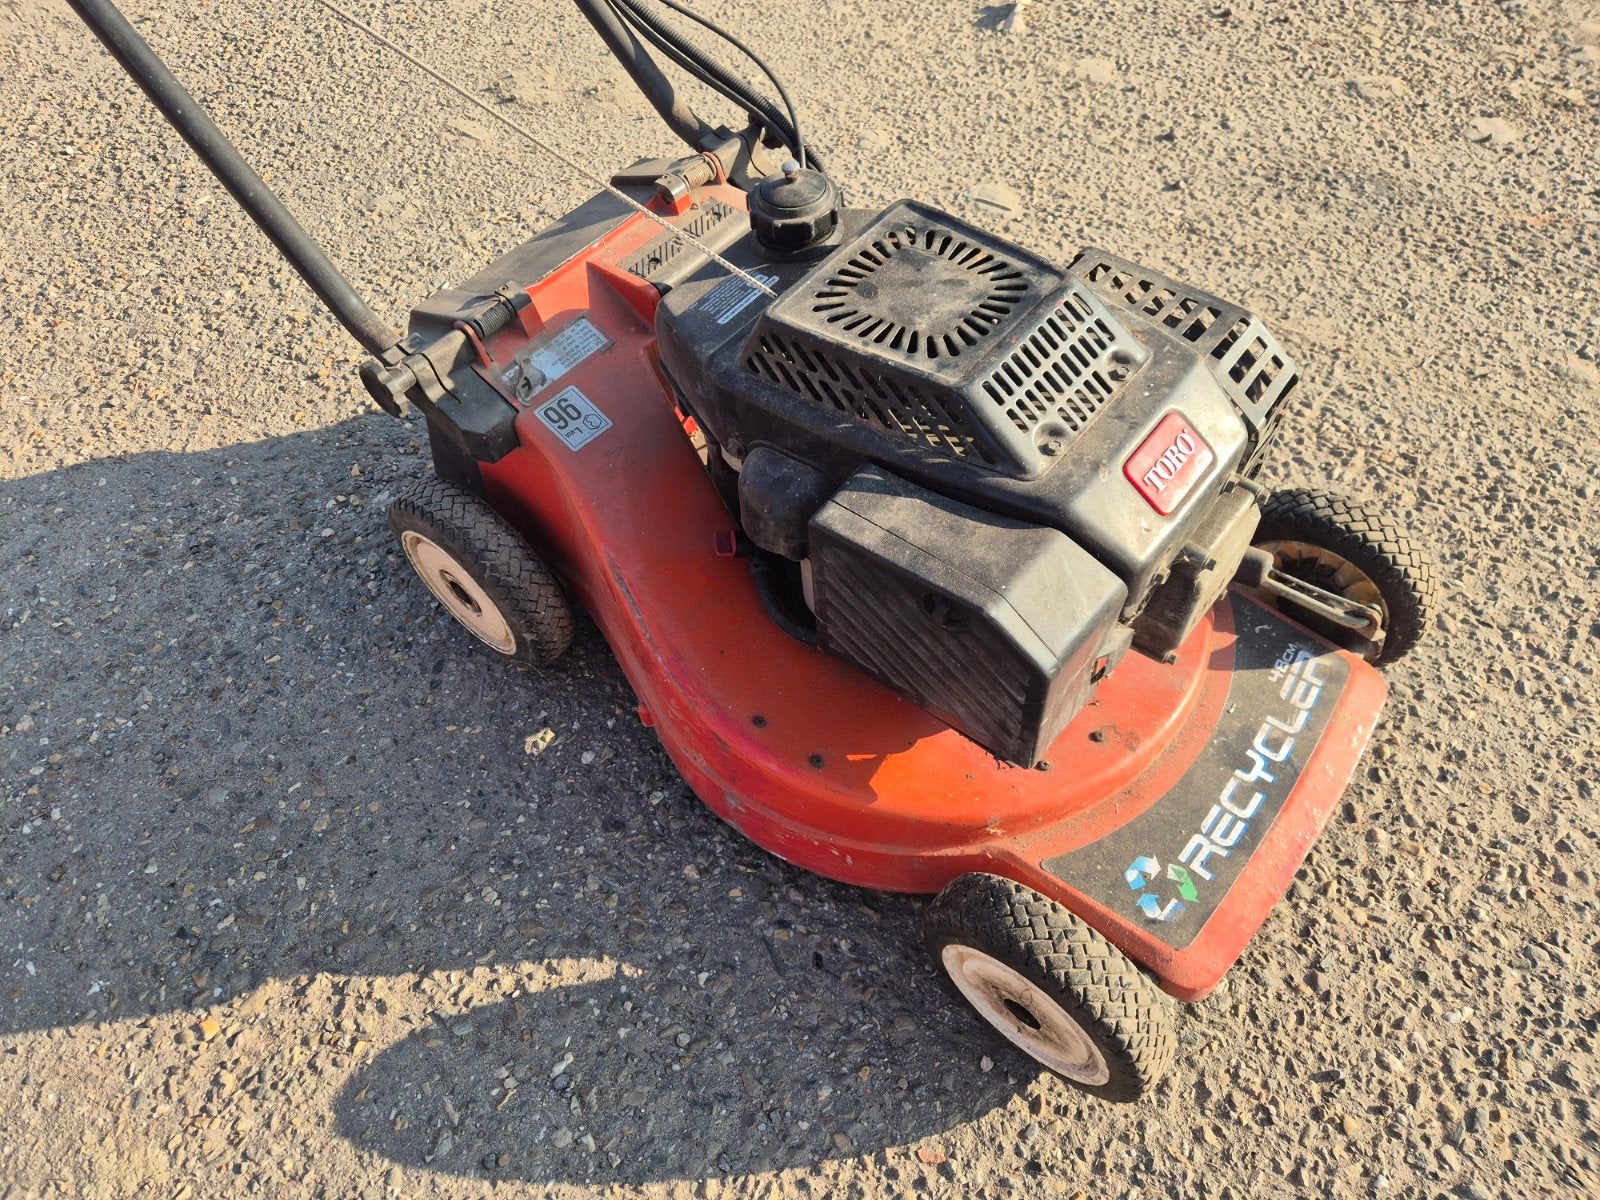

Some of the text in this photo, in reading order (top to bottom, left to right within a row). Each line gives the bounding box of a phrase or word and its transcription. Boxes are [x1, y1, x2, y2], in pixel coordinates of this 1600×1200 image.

[543, 397, 583, 431] 96
[1143, 432, 1196, 493] TORO
[1177, 650, 1331, 881] RECYCLER
